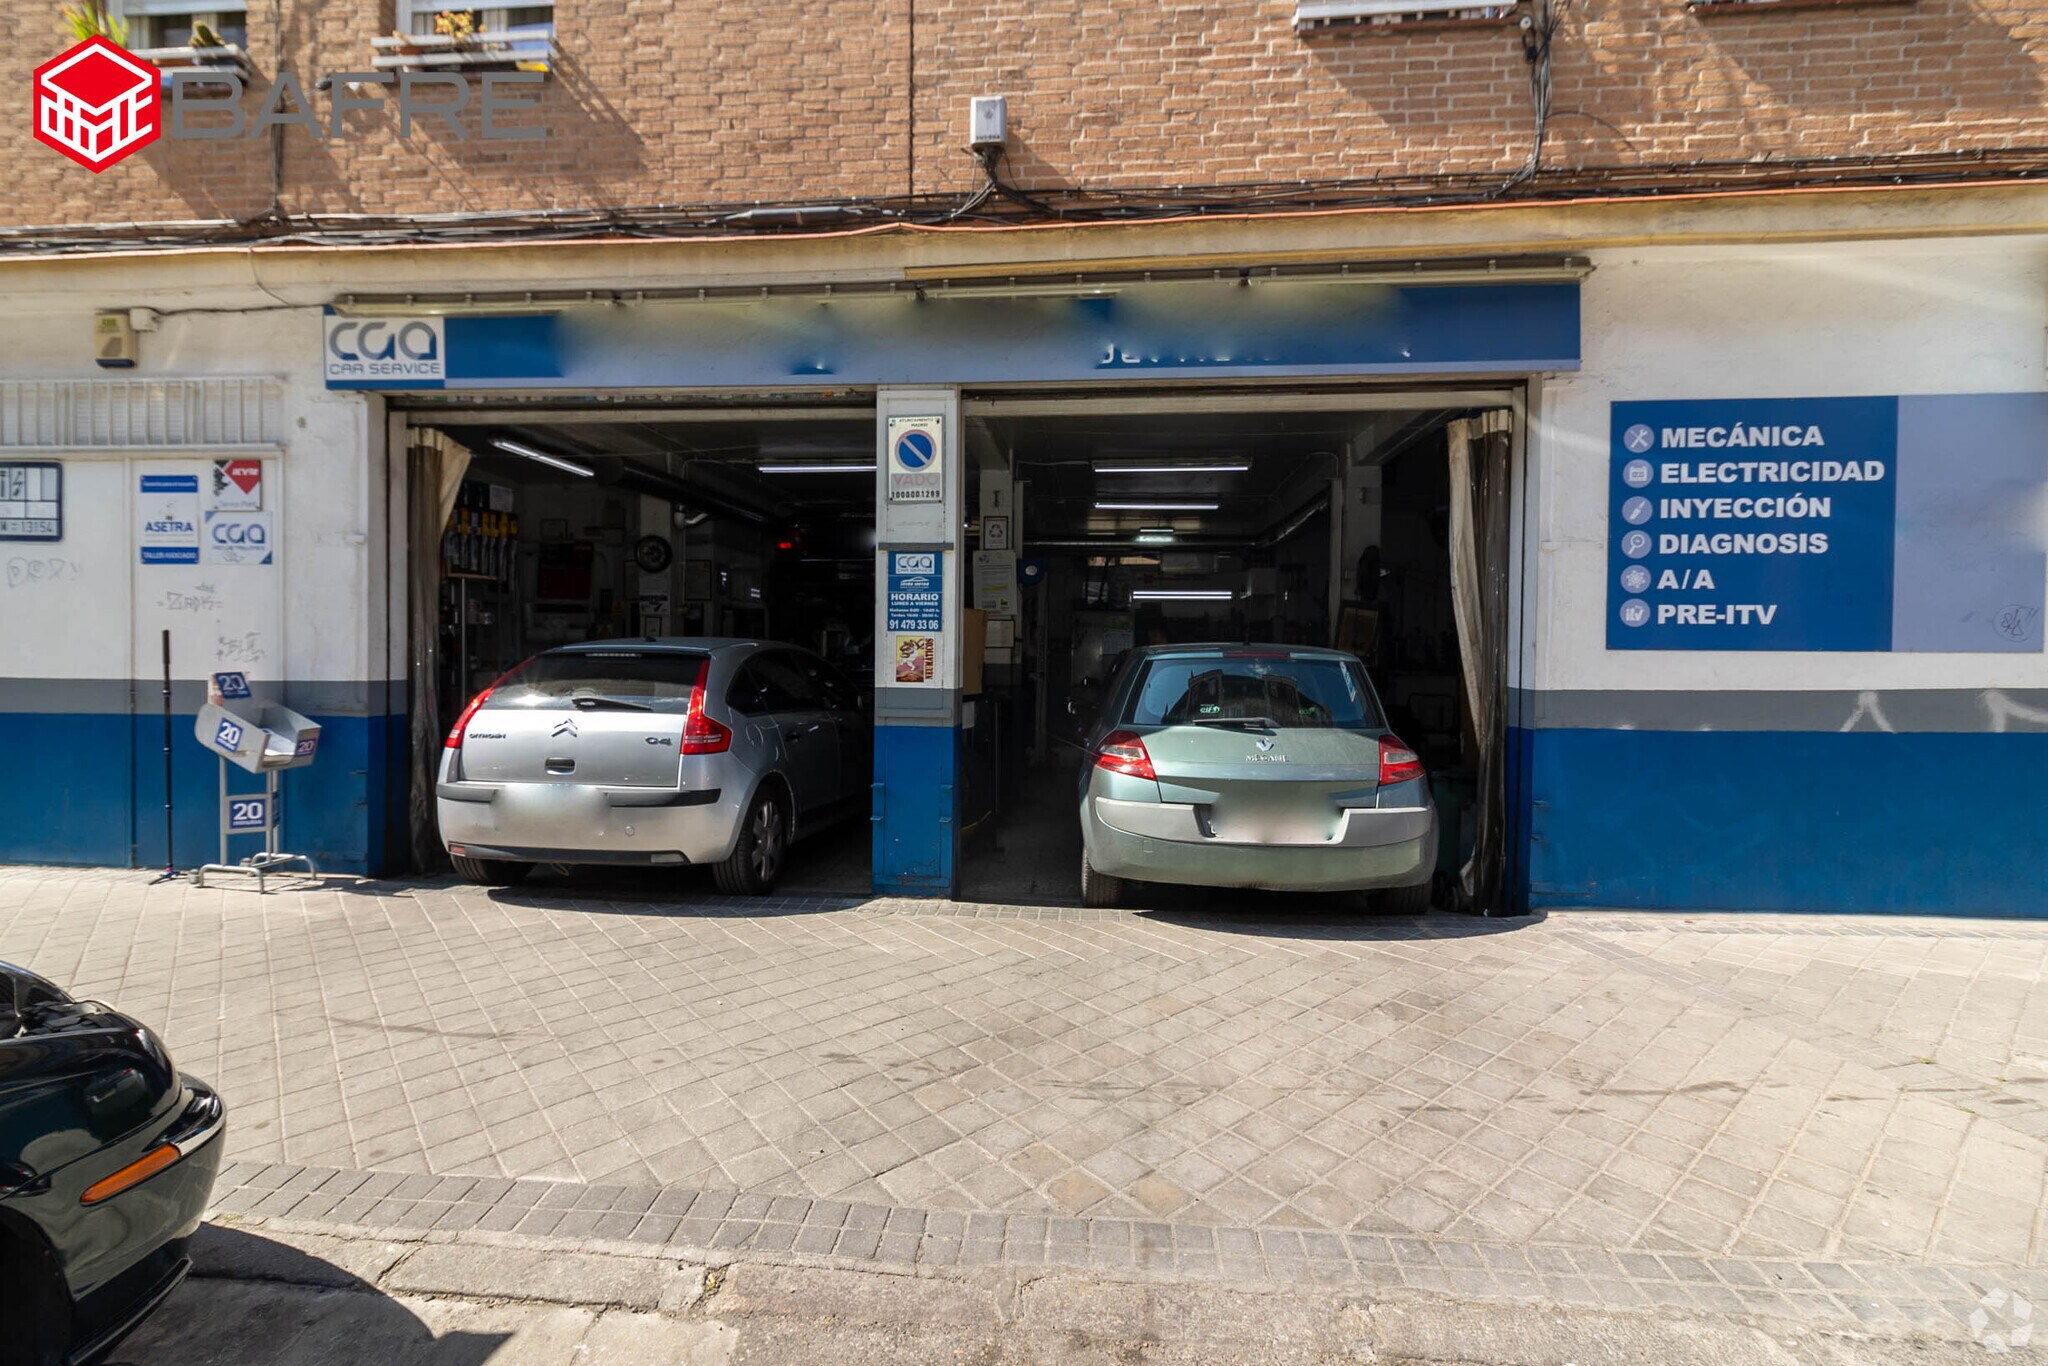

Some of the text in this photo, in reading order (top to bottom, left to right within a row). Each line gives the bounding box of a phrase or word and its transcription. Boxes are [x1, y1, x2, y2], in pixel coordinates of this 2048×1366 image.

[329, 362, 441, 375] CAR SERVICE
[1661, 422, 1826, 449] MECÁNICA
[891, 473, 938, 487] VADO
[1660, 460, 1886, 484] ELECTRICIDAD
[1659, 492, 1832, 519] INYECCIÓN
[144, 521, 194, 533] ASETRA
[1658, 532, 1829, 555] DIAGNOSIS
[890, 593, 939, 601] HORARIO
[889, 619, 939, 630] 91 479 33 06
[1657, 604, 1778, 626] PRE-ITV
[218, 721, 241, 745] 20
[297, 740, 315, 752] 20
[232, 801, 264, 821] 20
